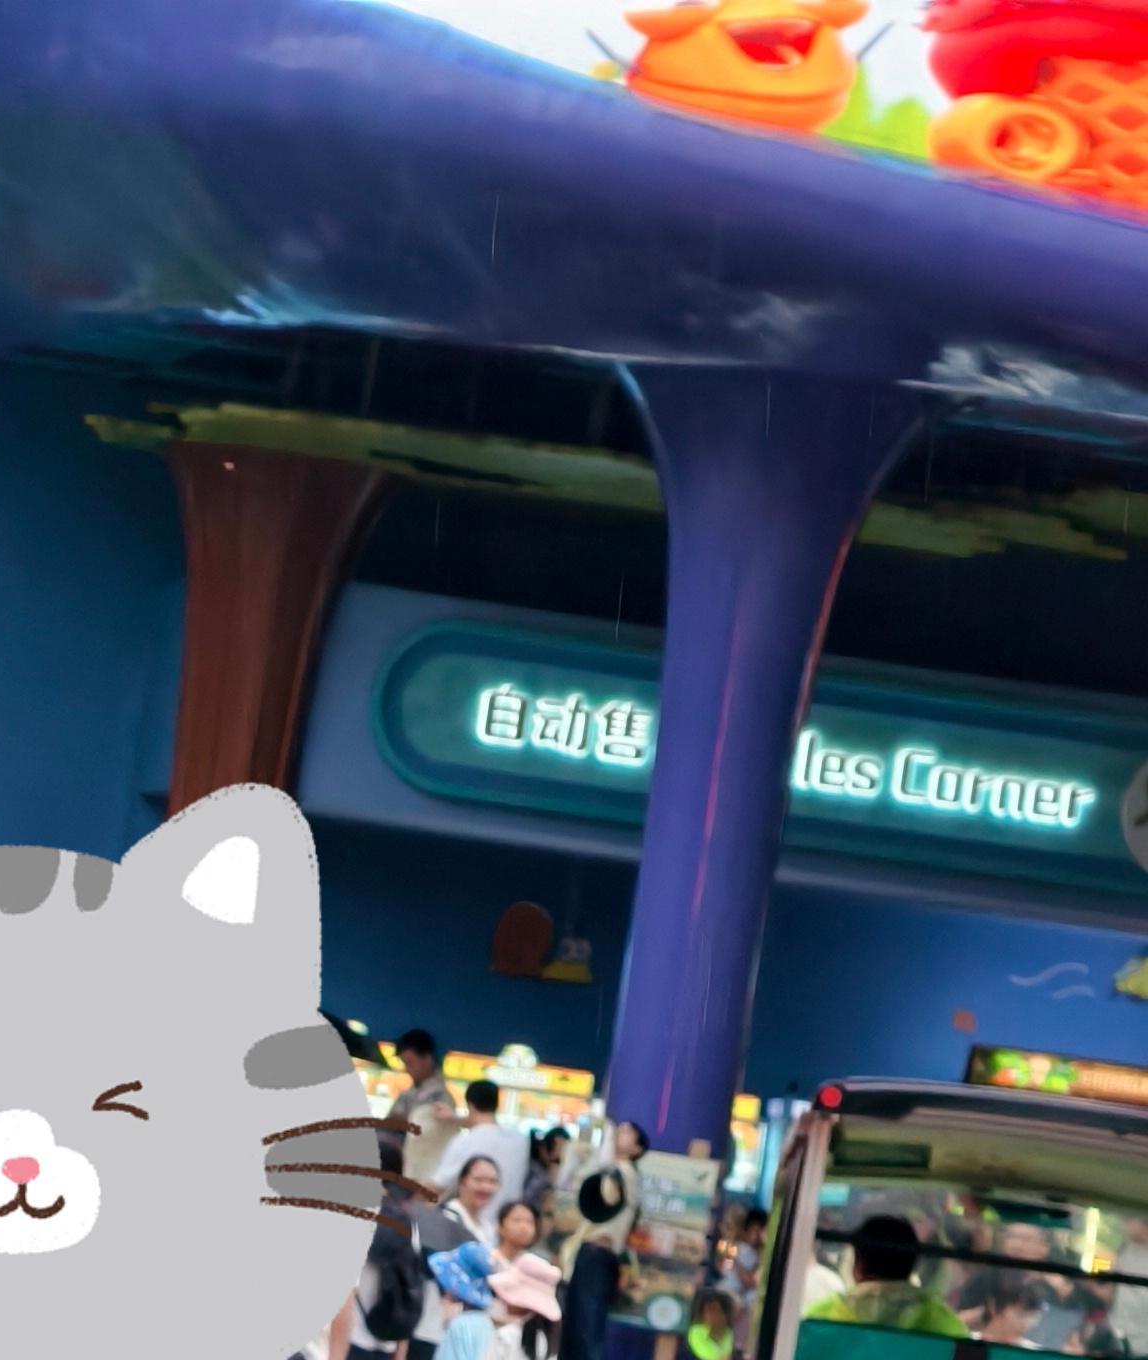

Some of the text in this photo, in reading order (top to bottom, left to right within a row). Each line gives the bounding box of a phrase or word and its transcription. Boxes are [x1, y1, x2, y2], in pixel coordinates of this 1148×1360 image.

[476, 682, 653, 767] 自动售
[891, 747, 1096, 828] Corner
